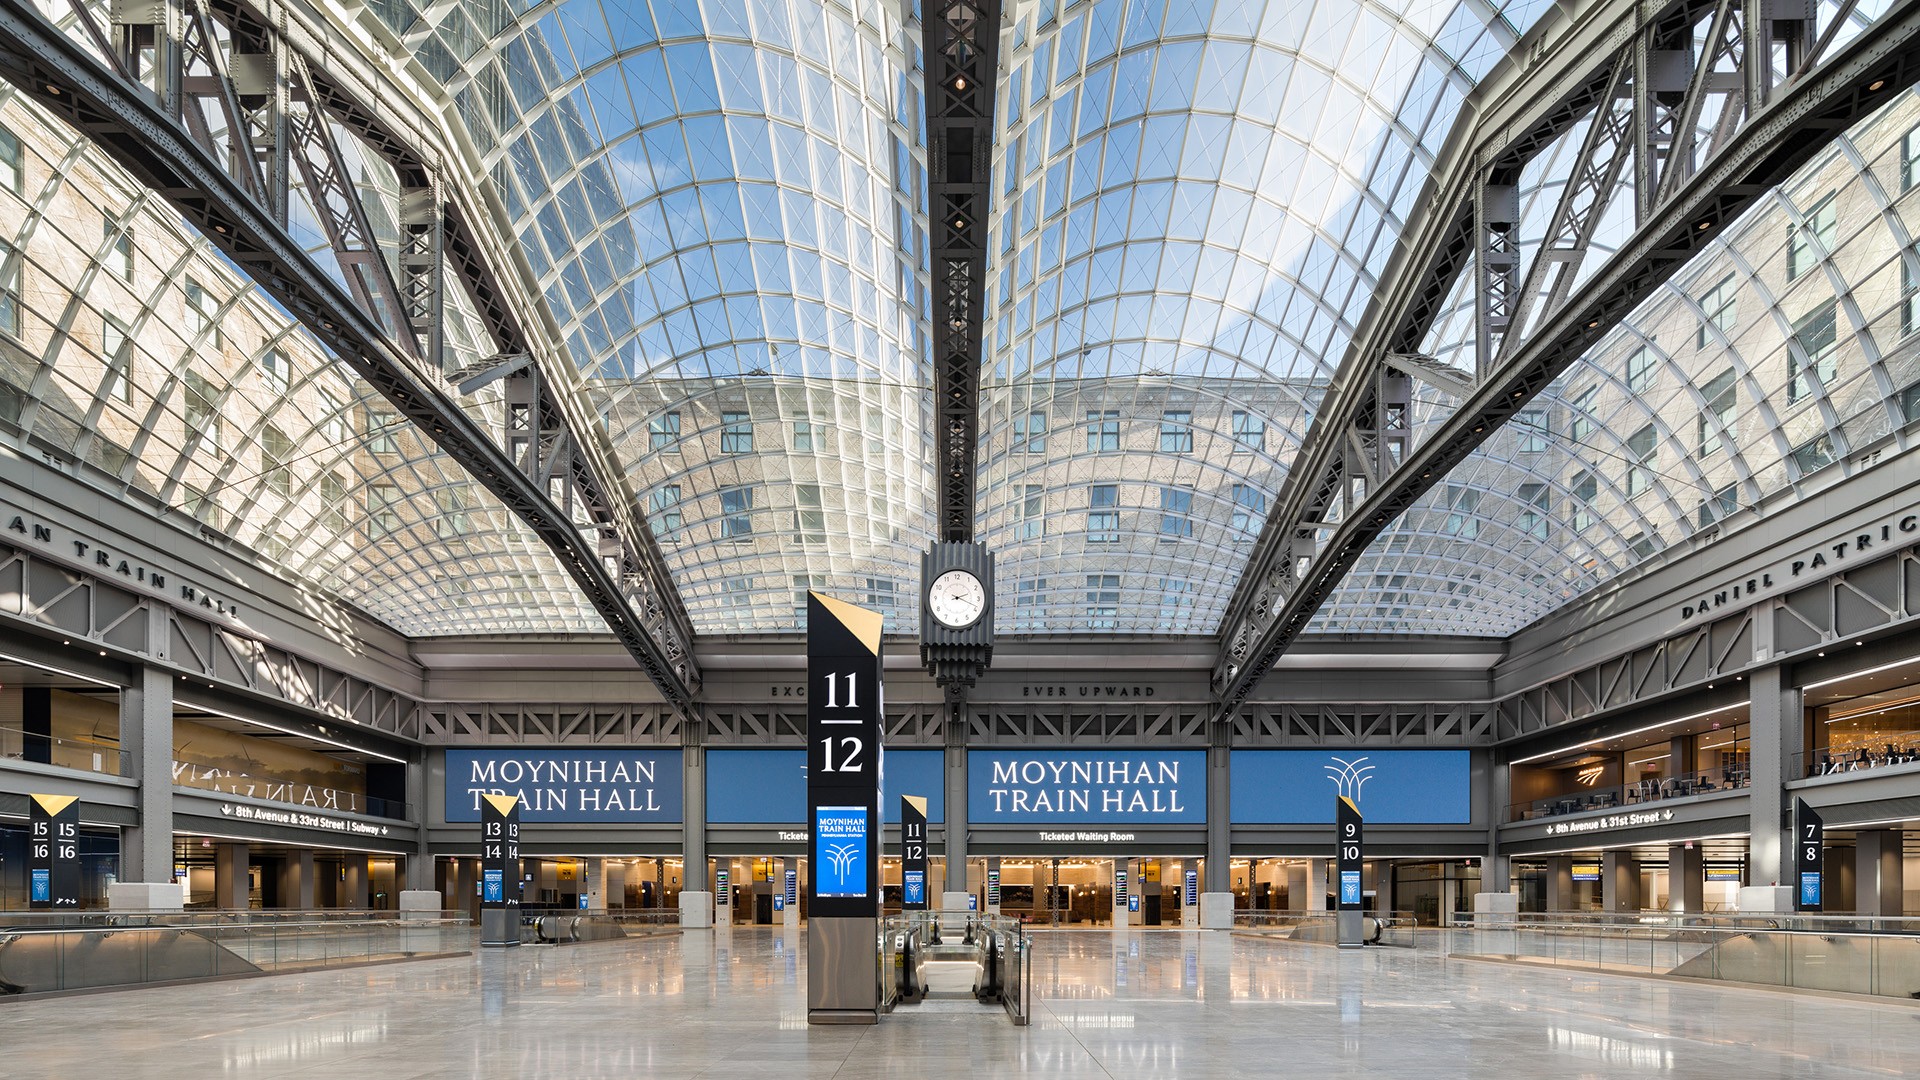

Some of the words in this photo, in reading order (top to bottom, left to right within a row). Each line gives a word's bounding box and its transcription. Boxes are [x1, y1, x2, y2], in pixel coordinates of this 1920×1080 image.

[8, 515, 52, 543] AN
[73, 540, 165, 589] TRAIN
[181, 585, 237, 619] HALL
[1682, 573, 1773, 620] DANIEL
[1791, 515, 1917, 577] PATRIC
[771, 686, 805, 697] EXC
[824, 671, 860, 708] 11
[1023, 686, 1067, 697] EVER
[1079, 686, 1154, 697] UPWARD
[820, 736, 863, 773] 12
[470, 760, 656, 783] MOYNIHAN
[991, 761, 1180, 784] MOYNIHAN
[467, 788, 567, 811] TAIN
[579, 788, 661, 811] HALL
[989, 789, 1089, 812] TRAIN
[1101, 789, 1185, 812] HALL
[235, 805, 252, 818] 8th
[254, 808, 289, 823] Avenue
[290, 813, 298, 824] &
[299, 814, 319, 827] 33rd
[320, 817, 345, 830] Street
[351, 822, 379, 836] Subway
[1555, 823, 1568, 834] 8th
[1570, 821, 1599, 832] Avenue
[1600, 818, 1608, 828] &
[1609, 815, 1628, 827] 31st
[1629, 812, 1660, 824] Street
[33, 822, 48, 835] 15
[59, 823, 75, 837] 15
[486, 822, 501, 836] 13
[508, 823, 518, 837] 13
[907, 823, 920, 837] 11
[1345, 823, 1356, 837] 9
[1806, 824, 1816, 838] 7
[1039, 832, 1075, 841] Ticketed
[1076, 832, 1109, 842] Waiting
[1110, 832, 1135, 841] Room
[33, 844, 48, 858] 16
[59, 845, 76, 859] 16
[485, 845, 501, 858] 14
[508, 845, 518, 859] 14
[906, 846, 922, 860] 12
[1342, 846, 1359, 860] 10
[1806, 847, 1816, 861] 8
